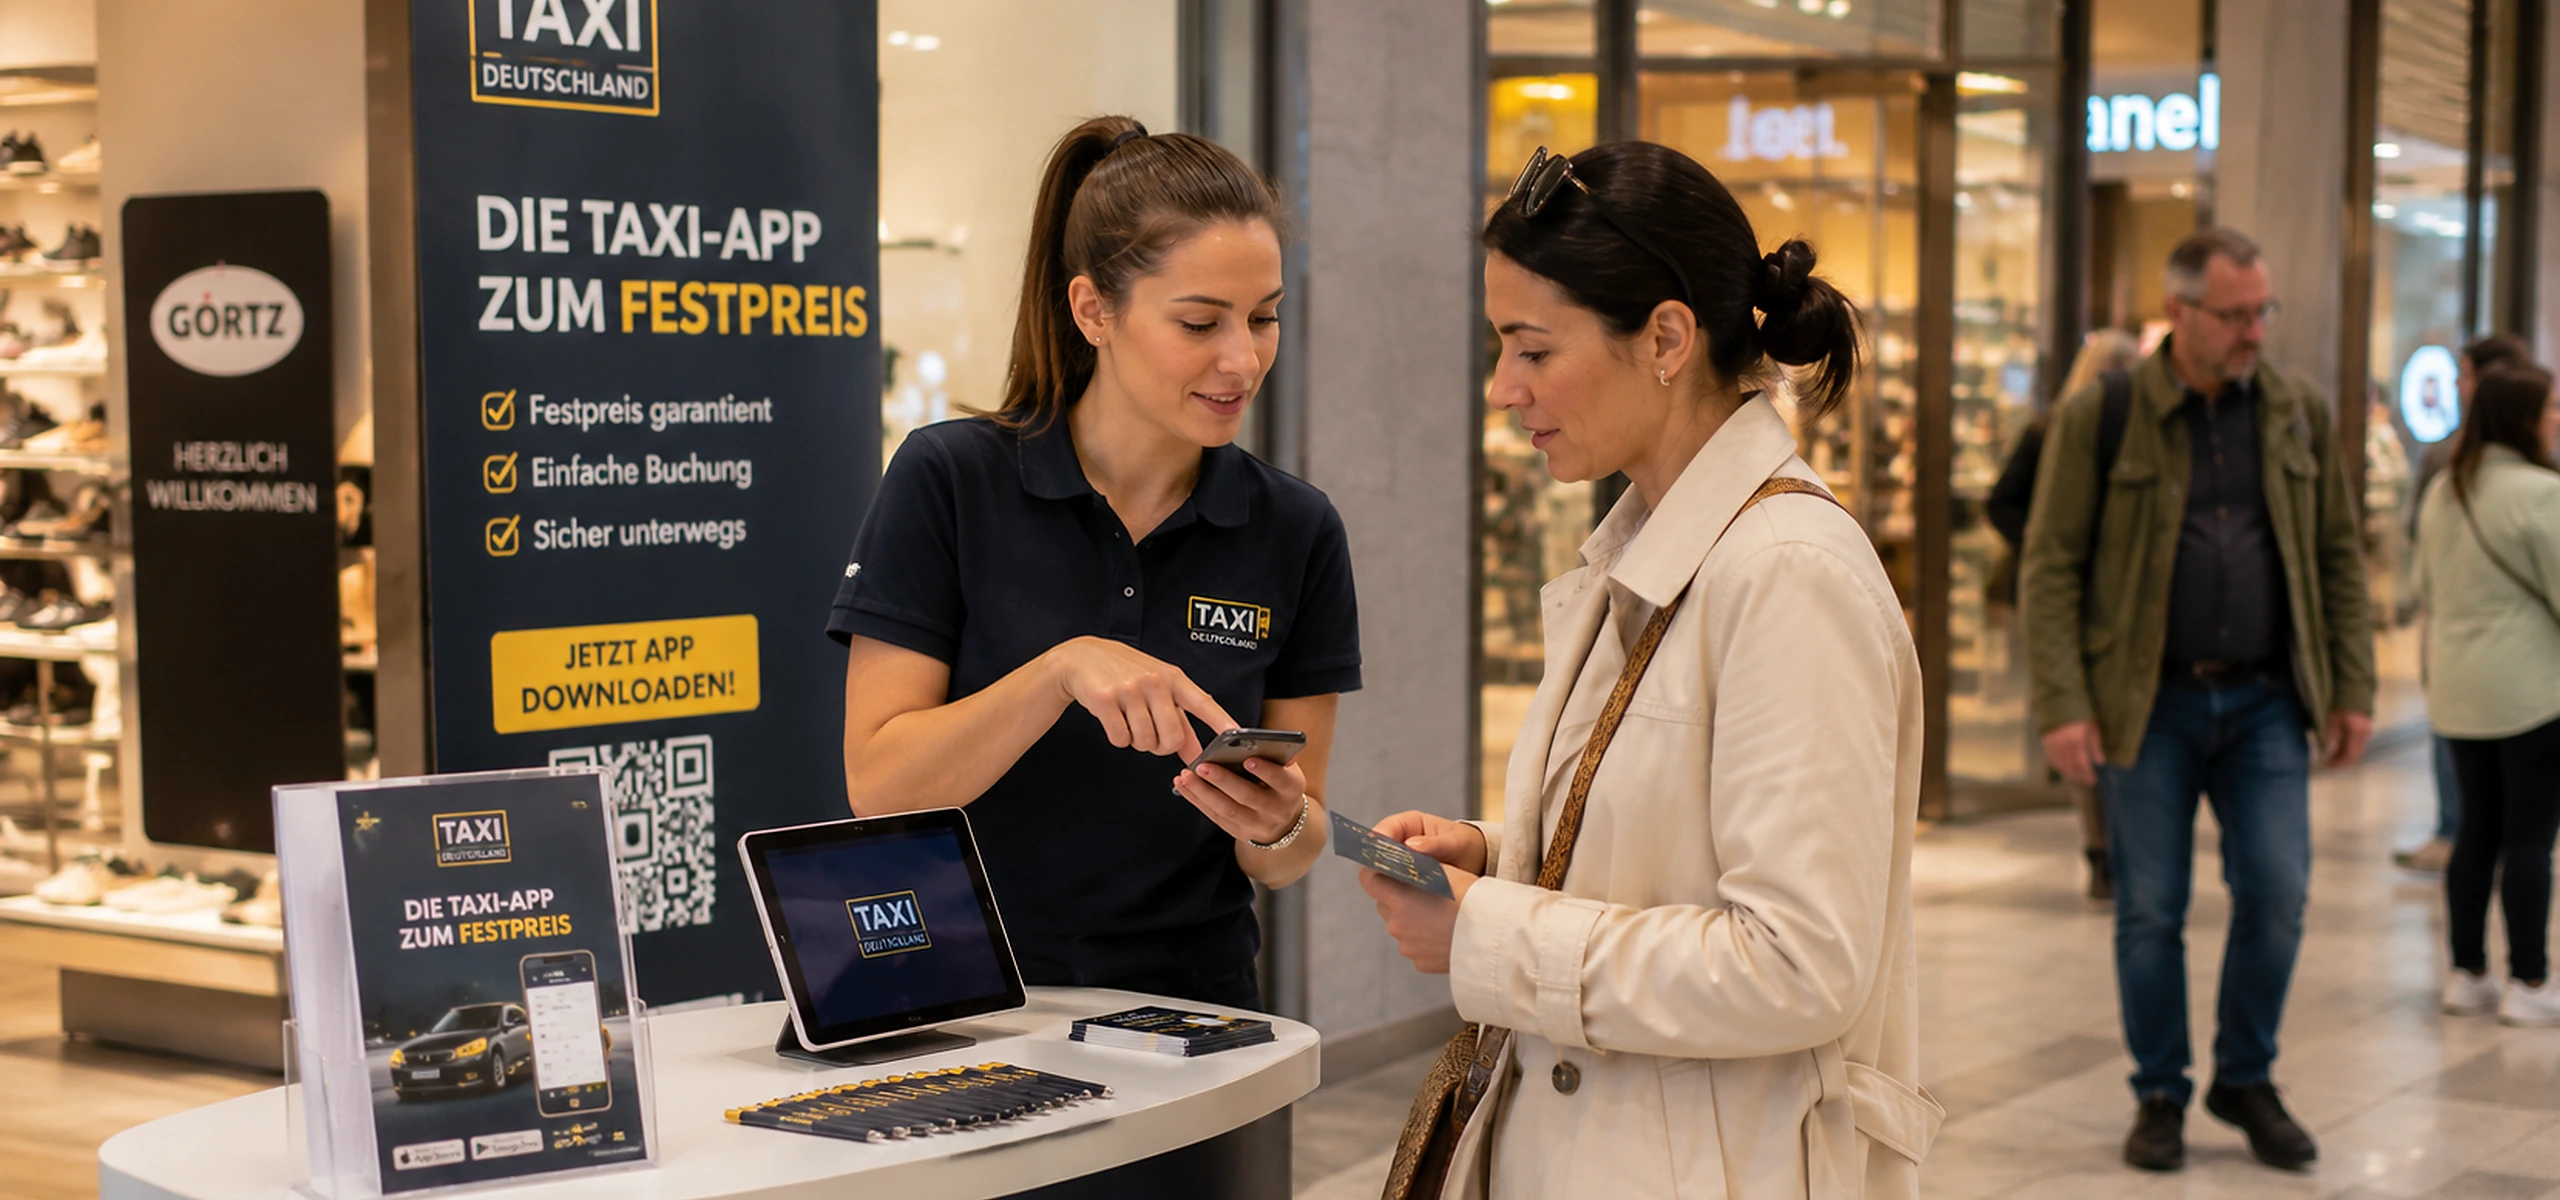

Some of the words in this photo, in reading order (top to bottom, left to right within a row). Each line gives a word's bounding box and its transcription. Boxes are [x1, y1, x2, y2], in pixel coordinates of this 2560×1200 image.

[482, 63, 650, 100] DEUTSCHLAND
[477, 195, 570, 253] DIE
[582, 199, 822, 262] TAXI-APP
[478, 275, 606, 333] ZUM
[621, 279, 868, 338] FESTPREIS
[530, 394, 644, 432] Festpreis
[650, 393, 773, 432] garantient
[532, 453, 639, 487] Einfache
[646, 452, 752, 489] Buchung
[533, 517, 613, 550] Sicher
[620, 519, 747, 550] unterwegs
[1194, 602, 1255, 634] TAXI
[564, 639, 637, 670] JETZT
[644, 635, 695, 663] APP
[521, 670, 736, 714] DOWNLOADEN!
[439, 818, 502, 845] TAXI
[404, 897, 444, 921] DIE
[447, 888, 555, 917] TAXI-APP
[853, 899, 917, 932] TAXI
[399, 924, 454, 950] ZUM
[459, 914, 573, 945] FESTPREIS
